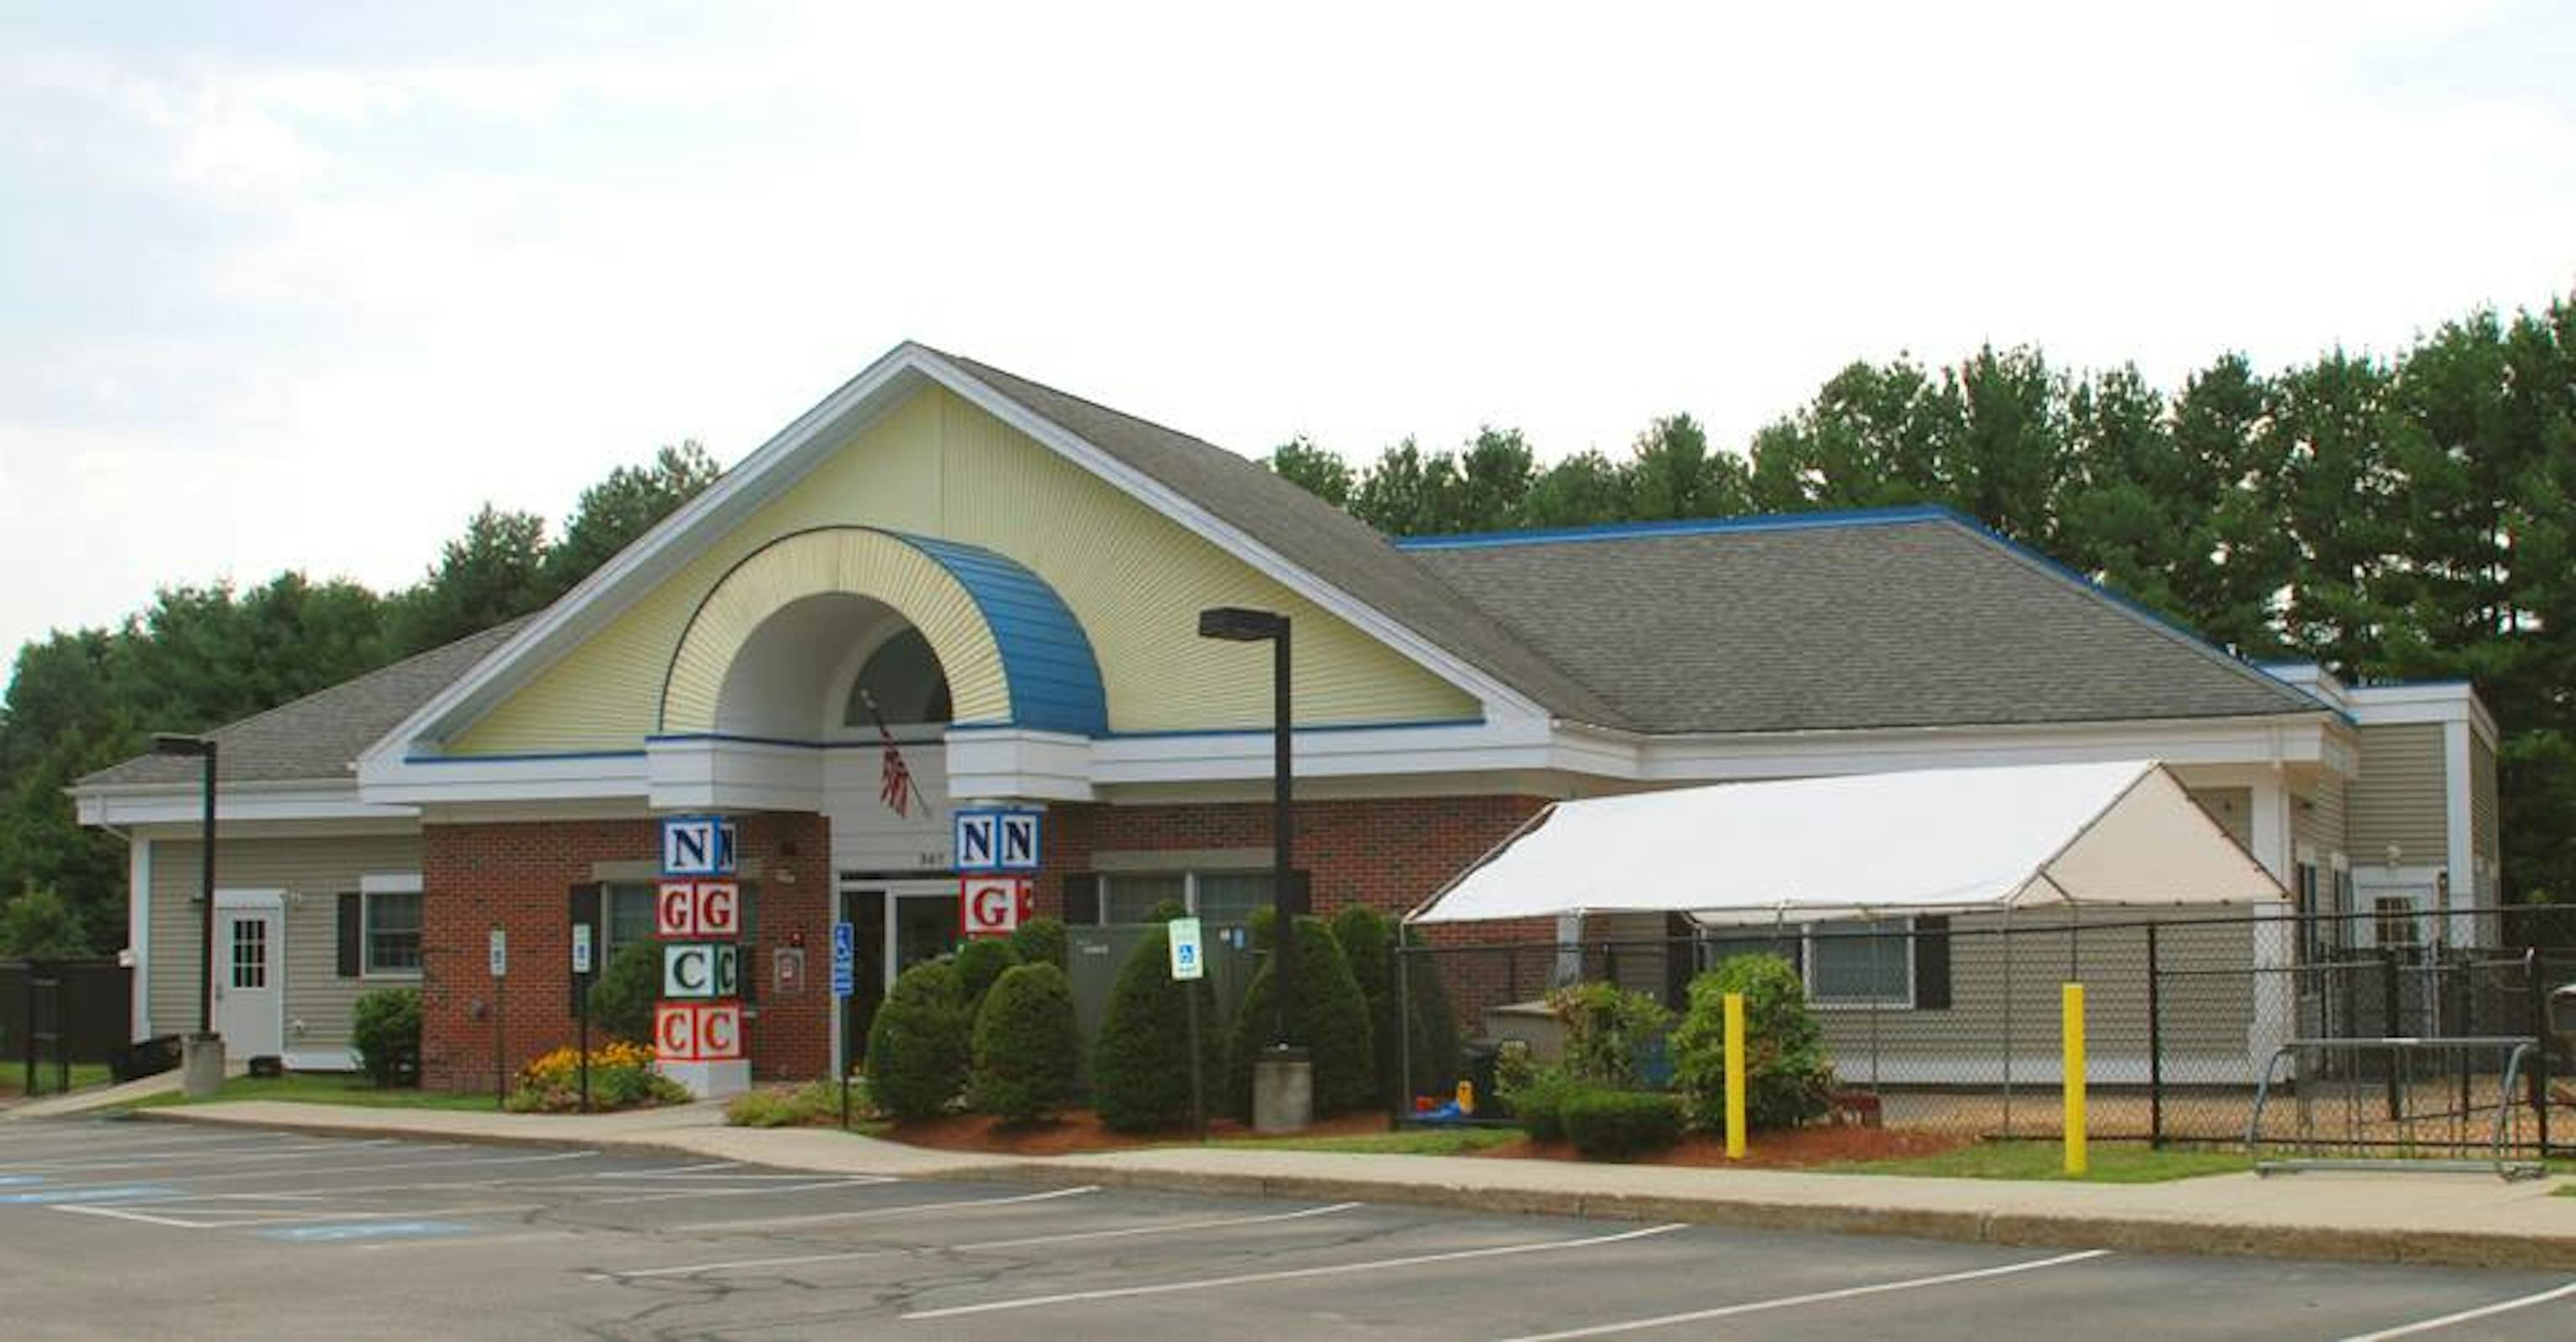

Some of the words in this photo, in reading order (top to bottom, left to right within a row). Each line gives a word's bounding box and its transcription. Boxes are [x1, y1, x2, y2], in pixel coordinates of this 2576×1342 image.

[673, 829, 709, 866] N
[963, 821, 991, 861] N
[1005, 821, 1031, 861] N
[665, 891, 687, 929] G
[704, 889, 730, 929] G
[974, 887, 1009, 927] G
[673, 950, 705, 990] C
[721, 951, 734, 989] C
[663, 1011, 687, 1052] C
[704, 1012, 730, 1052] C
